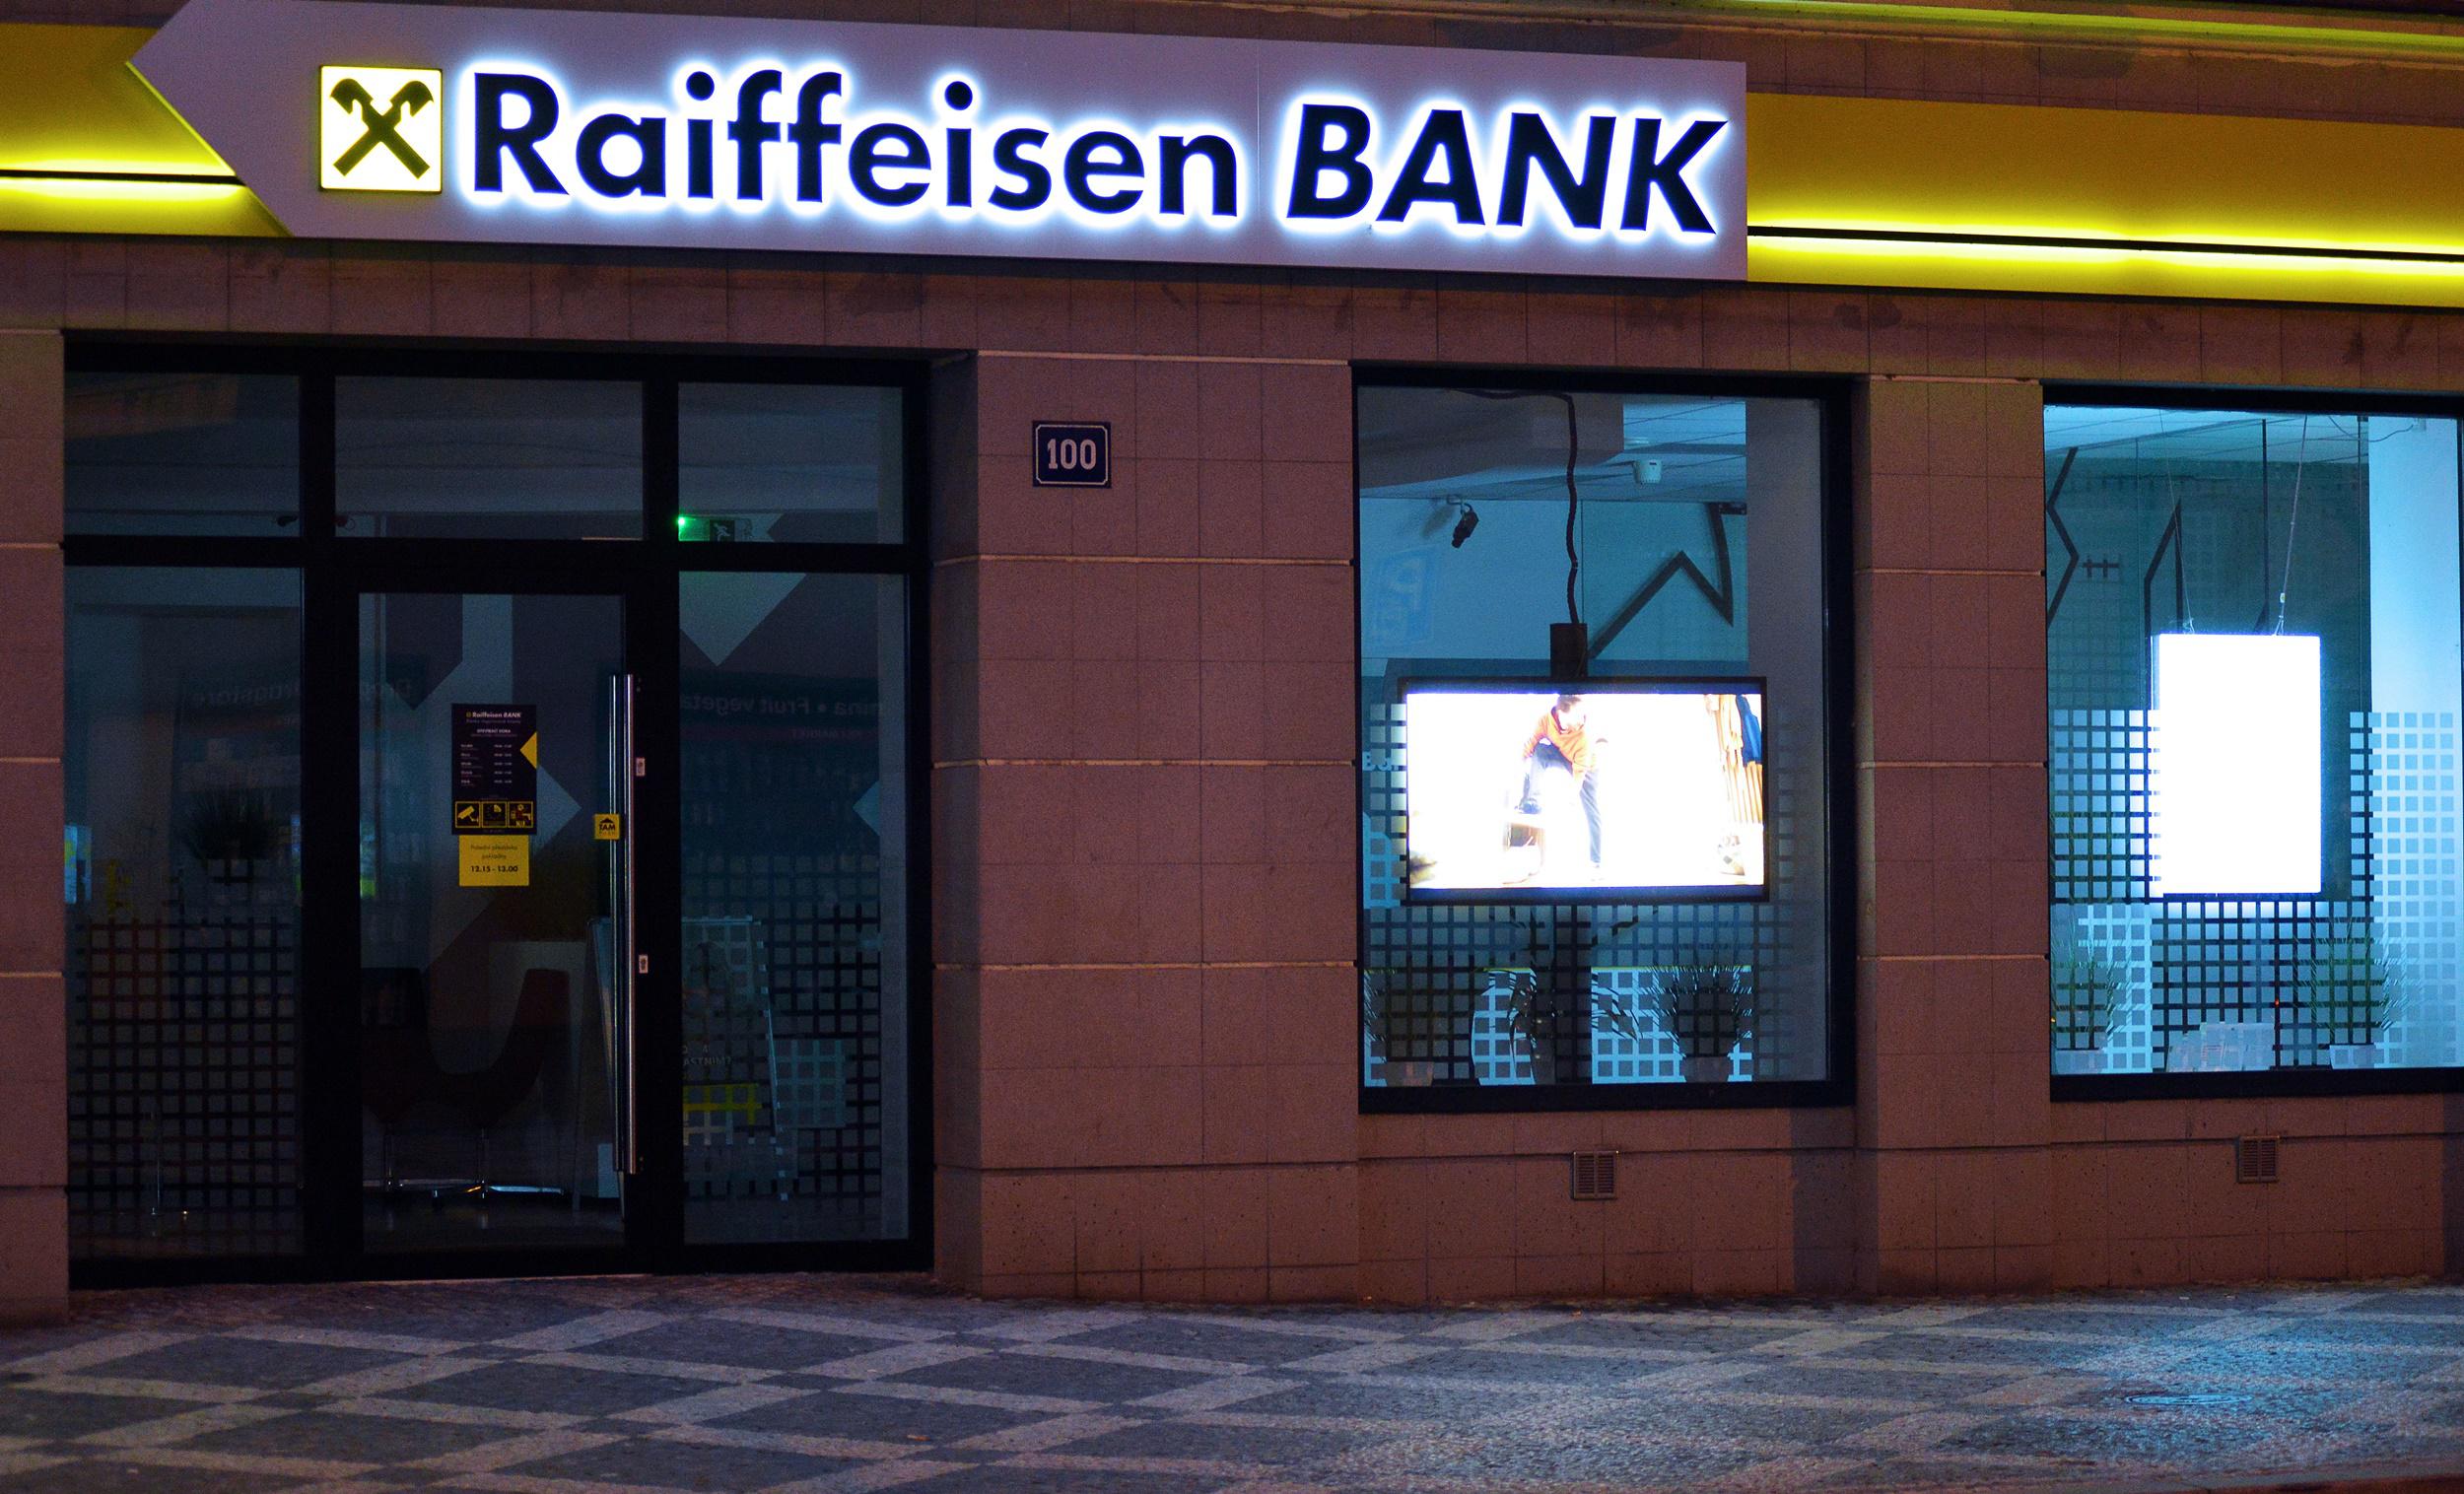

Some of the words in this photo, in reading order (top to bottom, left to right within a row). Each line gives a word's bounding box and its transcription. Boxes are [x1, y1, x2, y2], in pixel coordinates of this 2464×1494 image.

[473, 70, 1238, 217] Raiffeisen
[1286, 103, 1729, 235] BANK
[1047, 439, 1097, 470] 100
[598, 823, 616, 832] TAM
[471, 864, 491, 873] 12.15
[497, 864, 518, 873] 13.00
